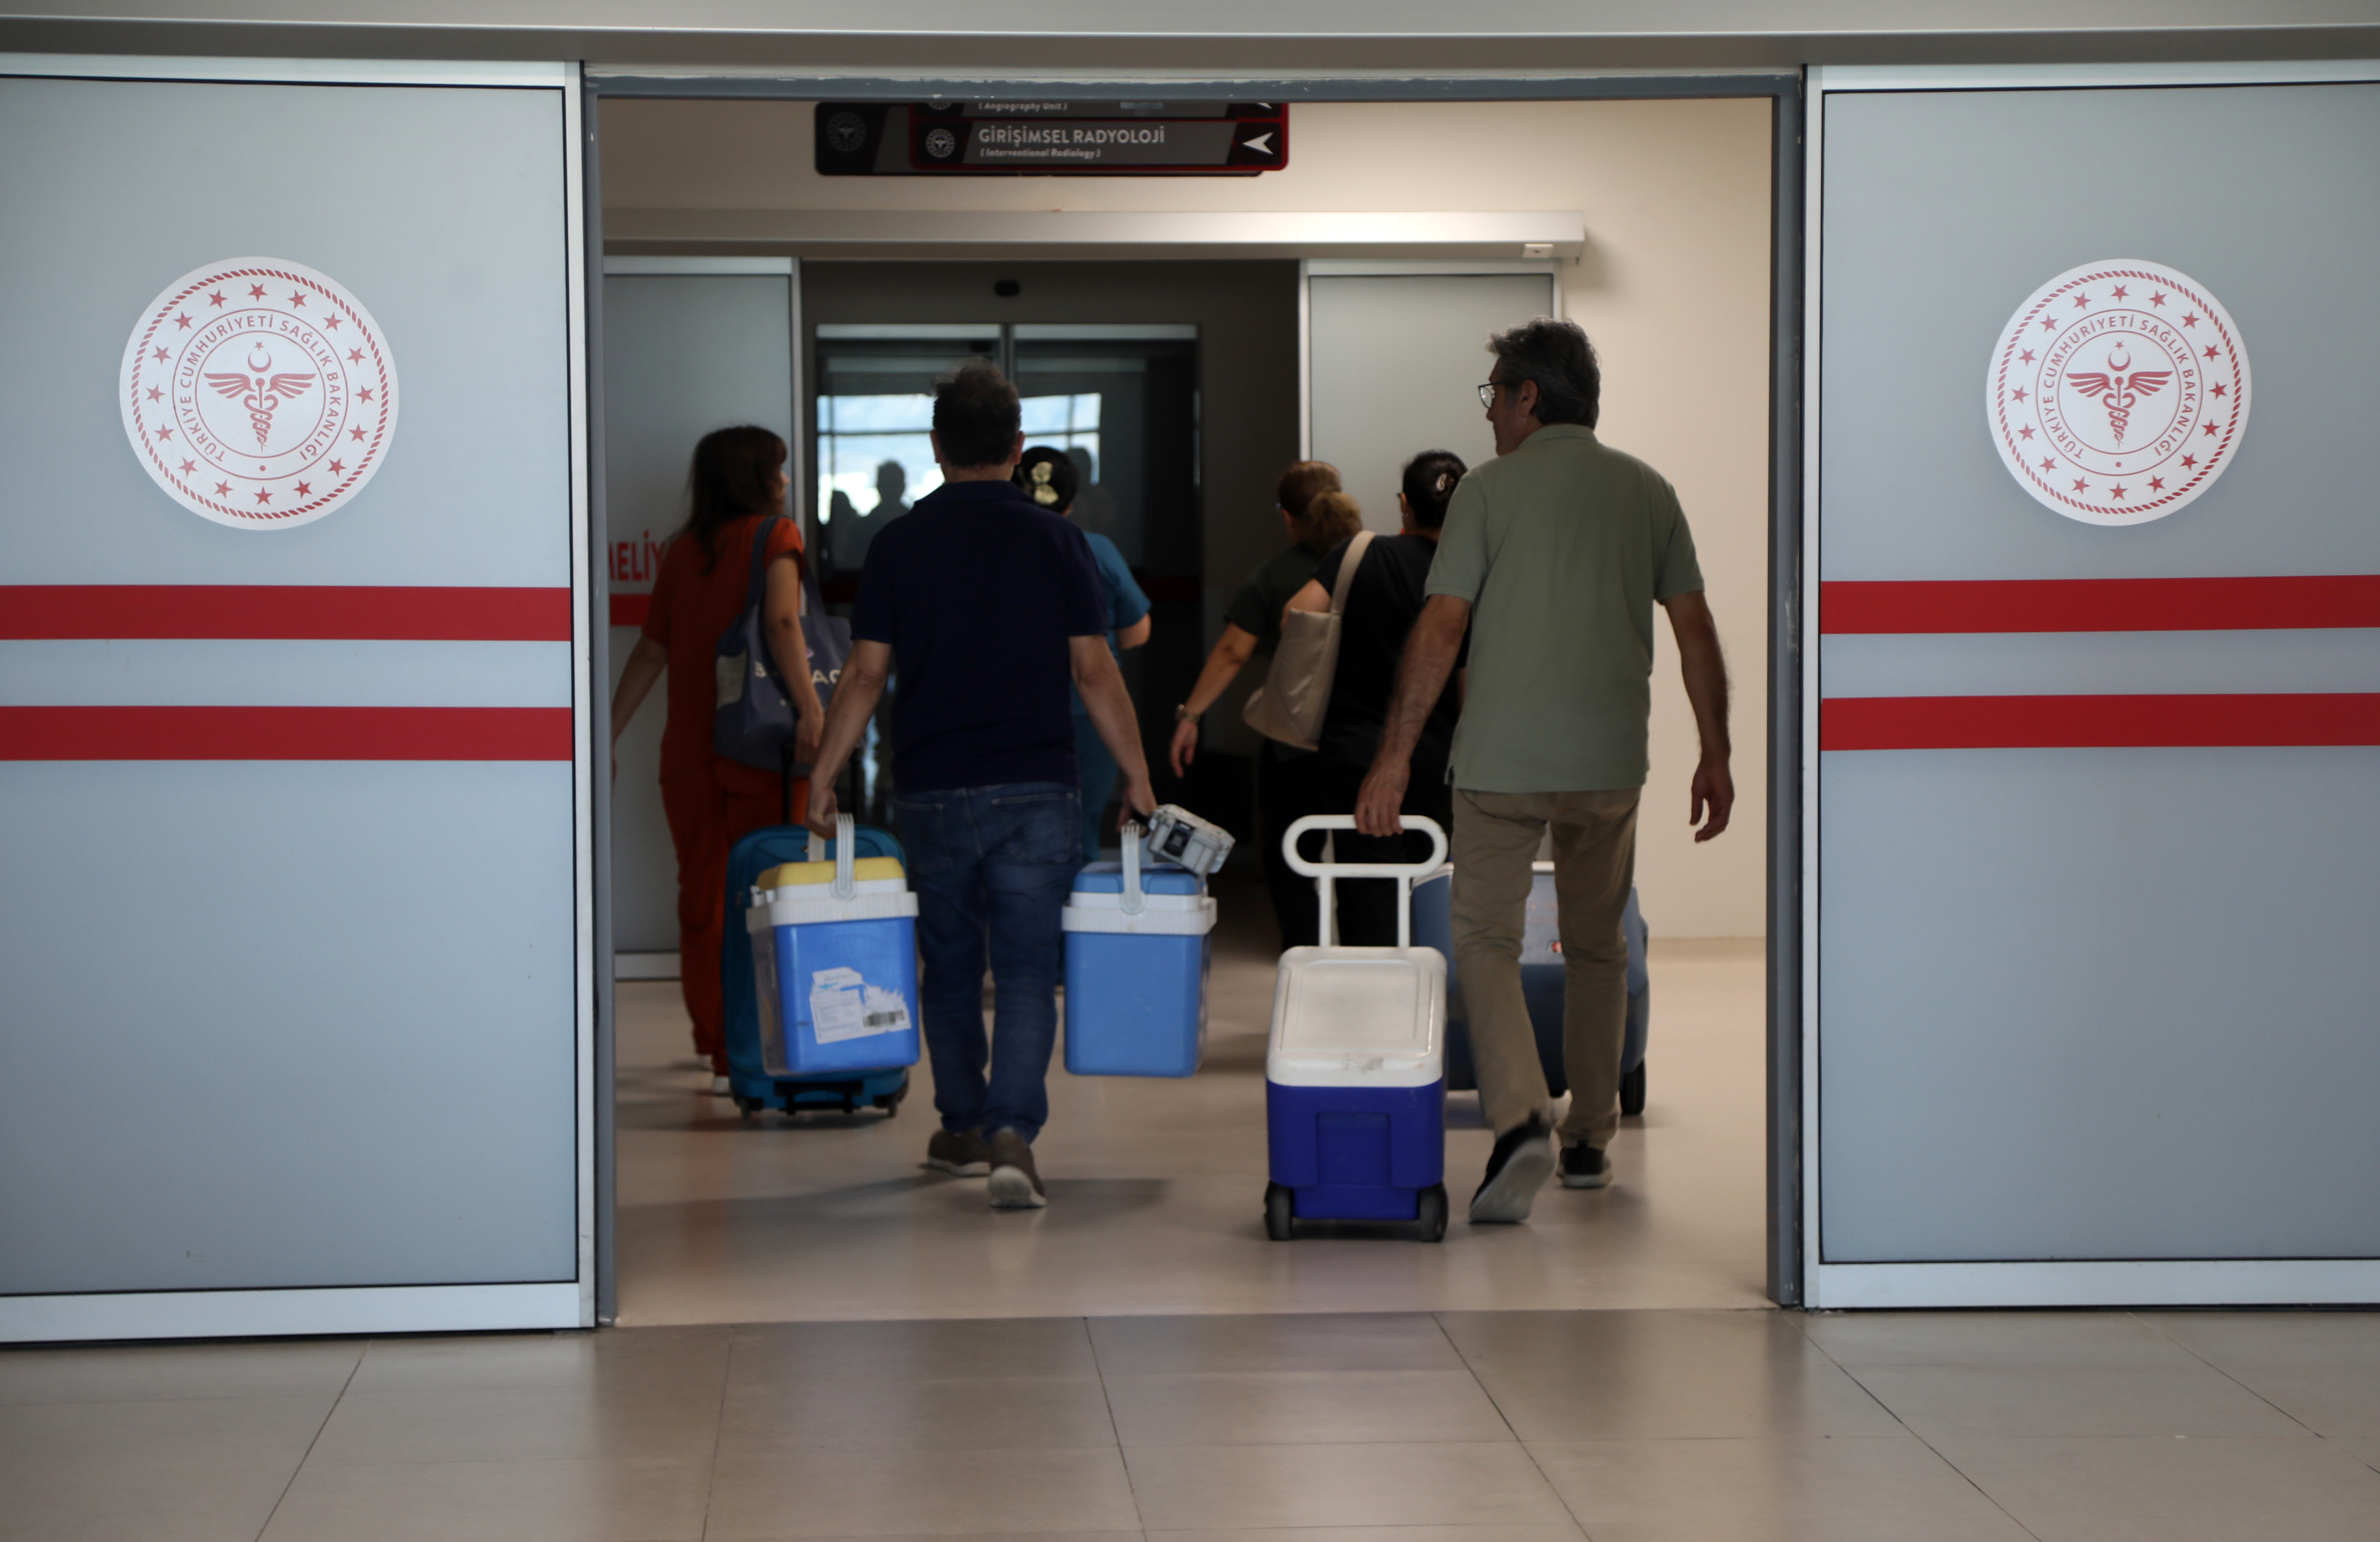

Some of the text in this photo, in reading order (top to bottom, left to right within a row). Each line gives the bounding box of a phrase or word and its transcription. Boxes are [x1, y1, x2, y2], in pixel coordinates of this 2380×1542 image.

[978, 125, 1165, 147] GİRİŞİMSEL RADYOLOJİ
[180, 313, 341, 462] TÜRKİYE CUMHURİYETİ SAĞLIK BAKANLIĞI
[2043, 313, 2196, 460] TÜRKİYE CUMHURİYETİ SAĞLIK BAKANLIĞI
